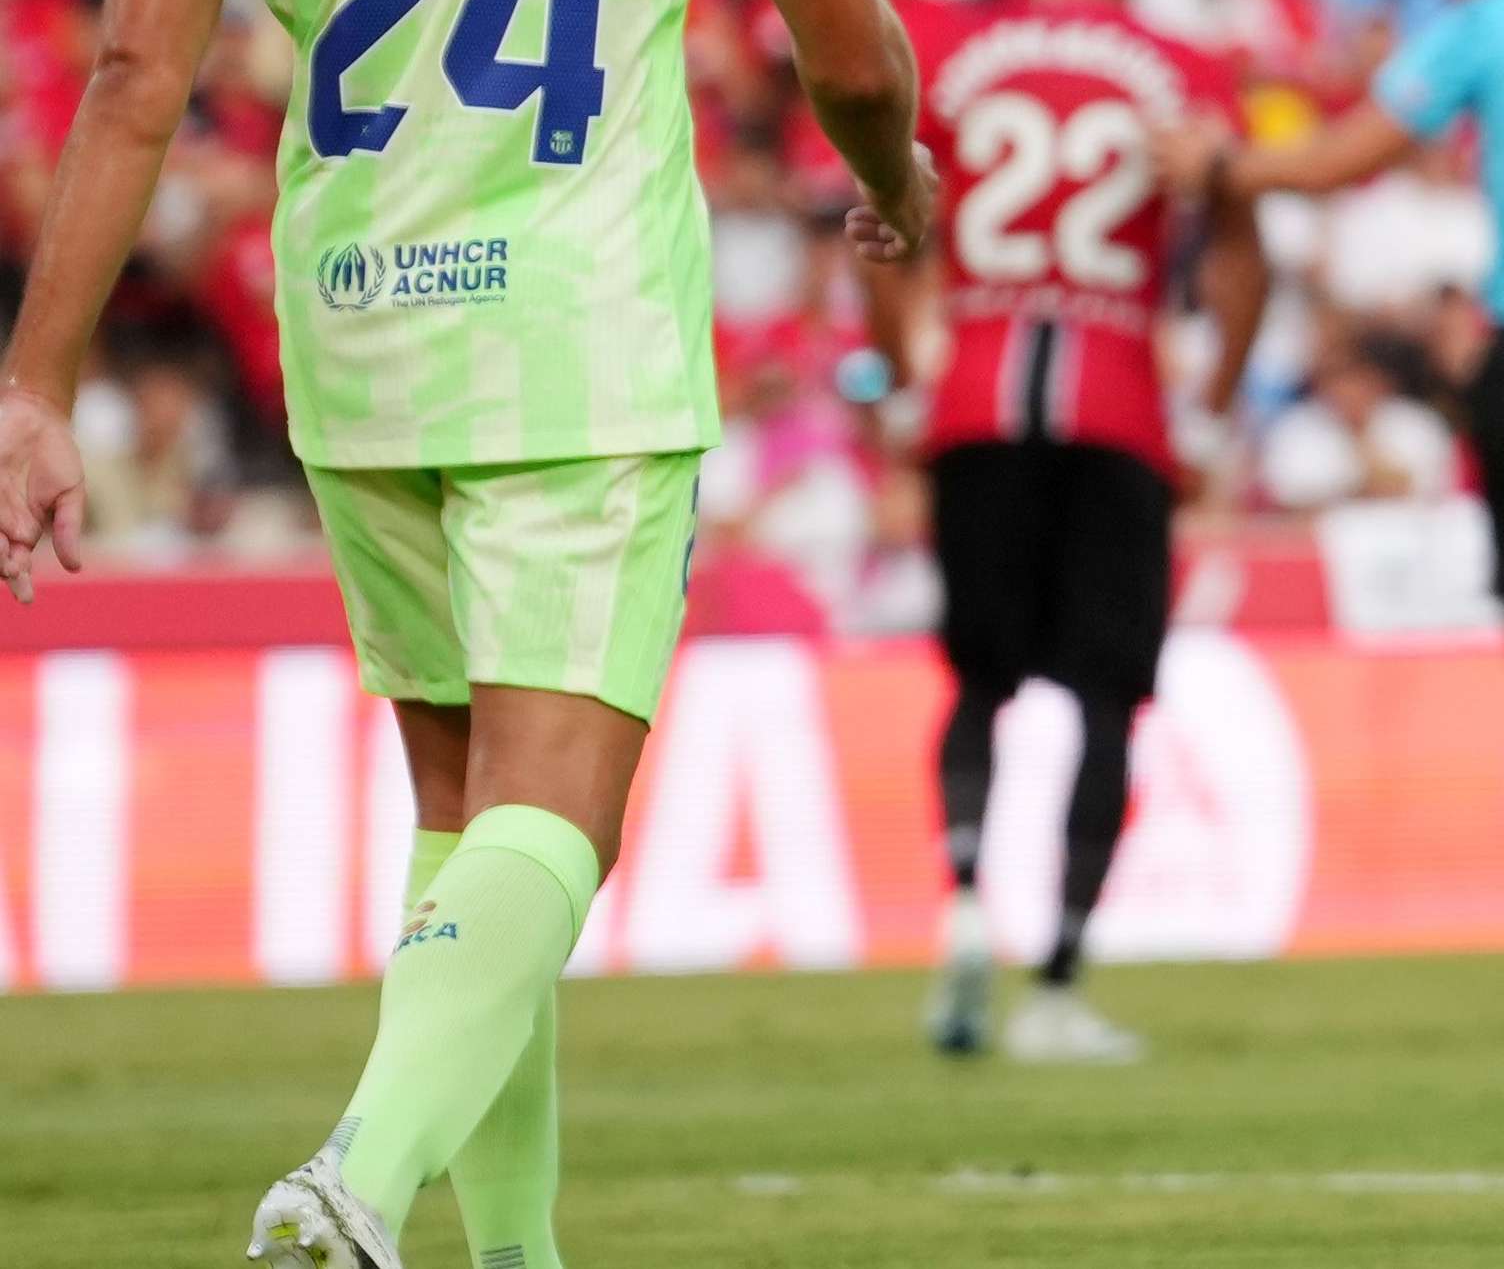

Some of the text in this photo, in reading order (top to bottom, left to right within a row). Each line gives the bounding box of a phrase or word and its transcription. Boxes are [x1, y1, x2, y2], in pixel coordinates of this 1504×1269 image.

[955, 91, 1148, 291] 22
[394, 238, 508, 270] UNHCR
[390, 265, 507, 296] ACNUR
